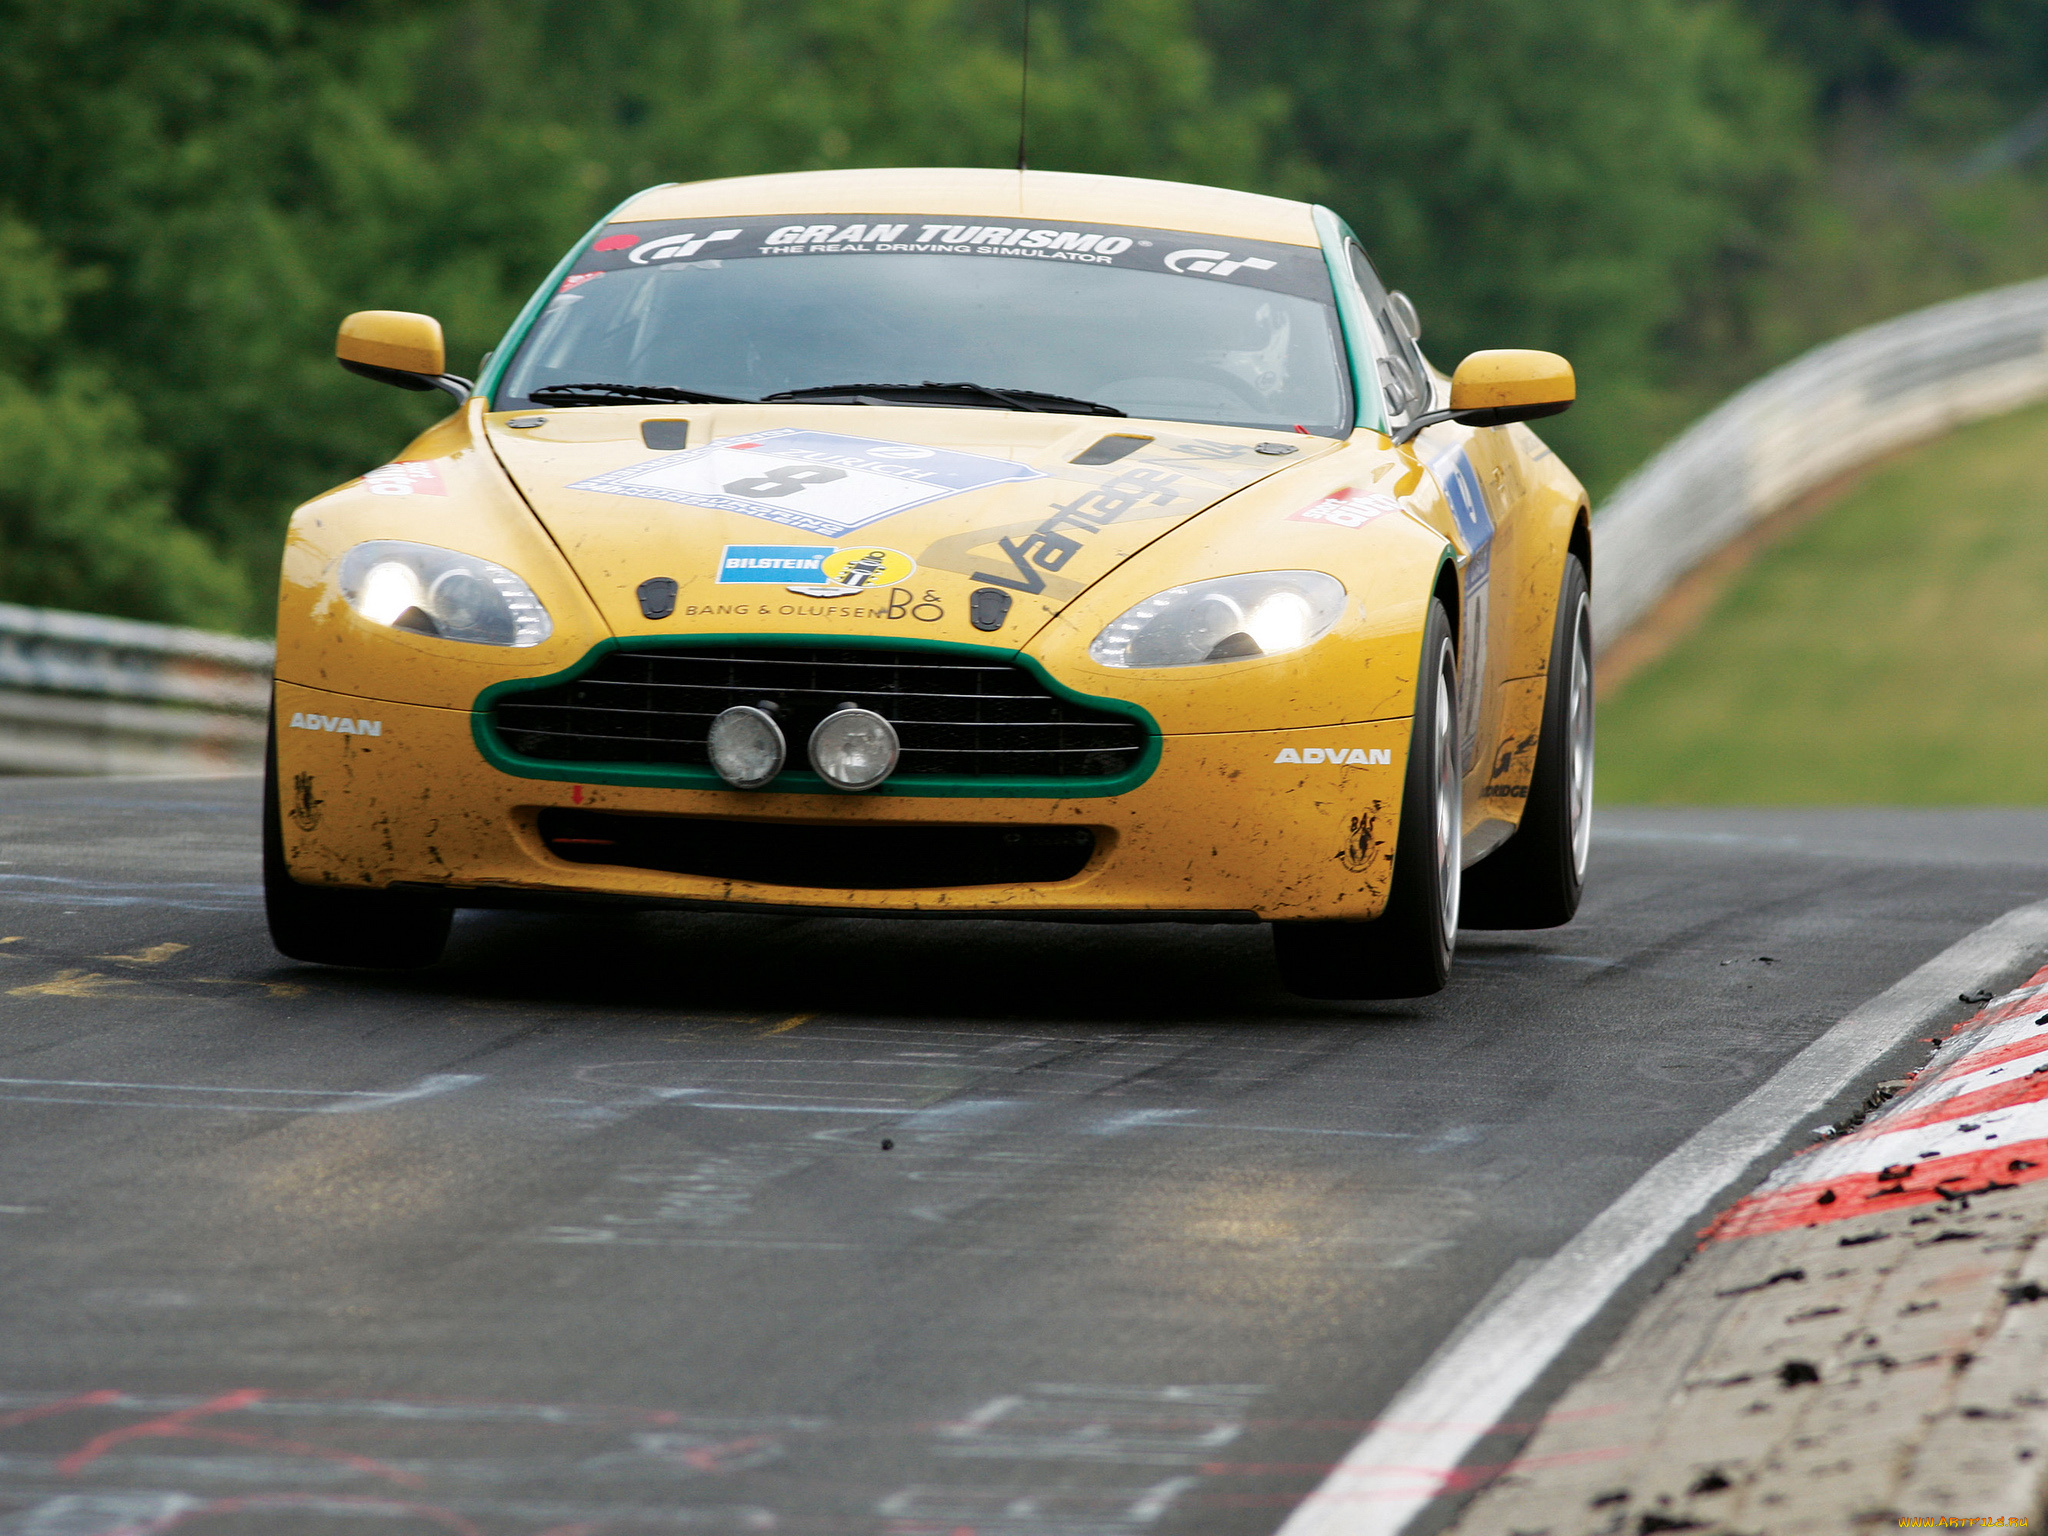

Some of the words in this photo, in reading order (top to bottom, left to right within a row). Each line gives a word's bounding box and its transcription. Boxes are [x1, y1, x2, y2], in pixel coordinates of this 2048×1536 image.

[765, 224, 909, 246] GRAN
[916, 224, 1133, 255] TURISMO
[759, 245, 805, 255] THE
[809, 243, 871, 253] REAL
[875, 243, 971, 253] DRIVING
[976, 246, 1112, 264] SIMULATOR
[776, 449, 938, 480] ZURICH
[722, 465, 849, 498] 8
[969, 468, 1185, 595] Vantage
[725, 558, 820, 570] BILSTEIN
[685, 605, 748, 616] BANG
[757, 605, 771, 616] &
[779, 605, 882, 619] OLUFSEN
[290, 713, 382, 736] ADVAN
[1273, 748, 1390, 765] ADVAN
